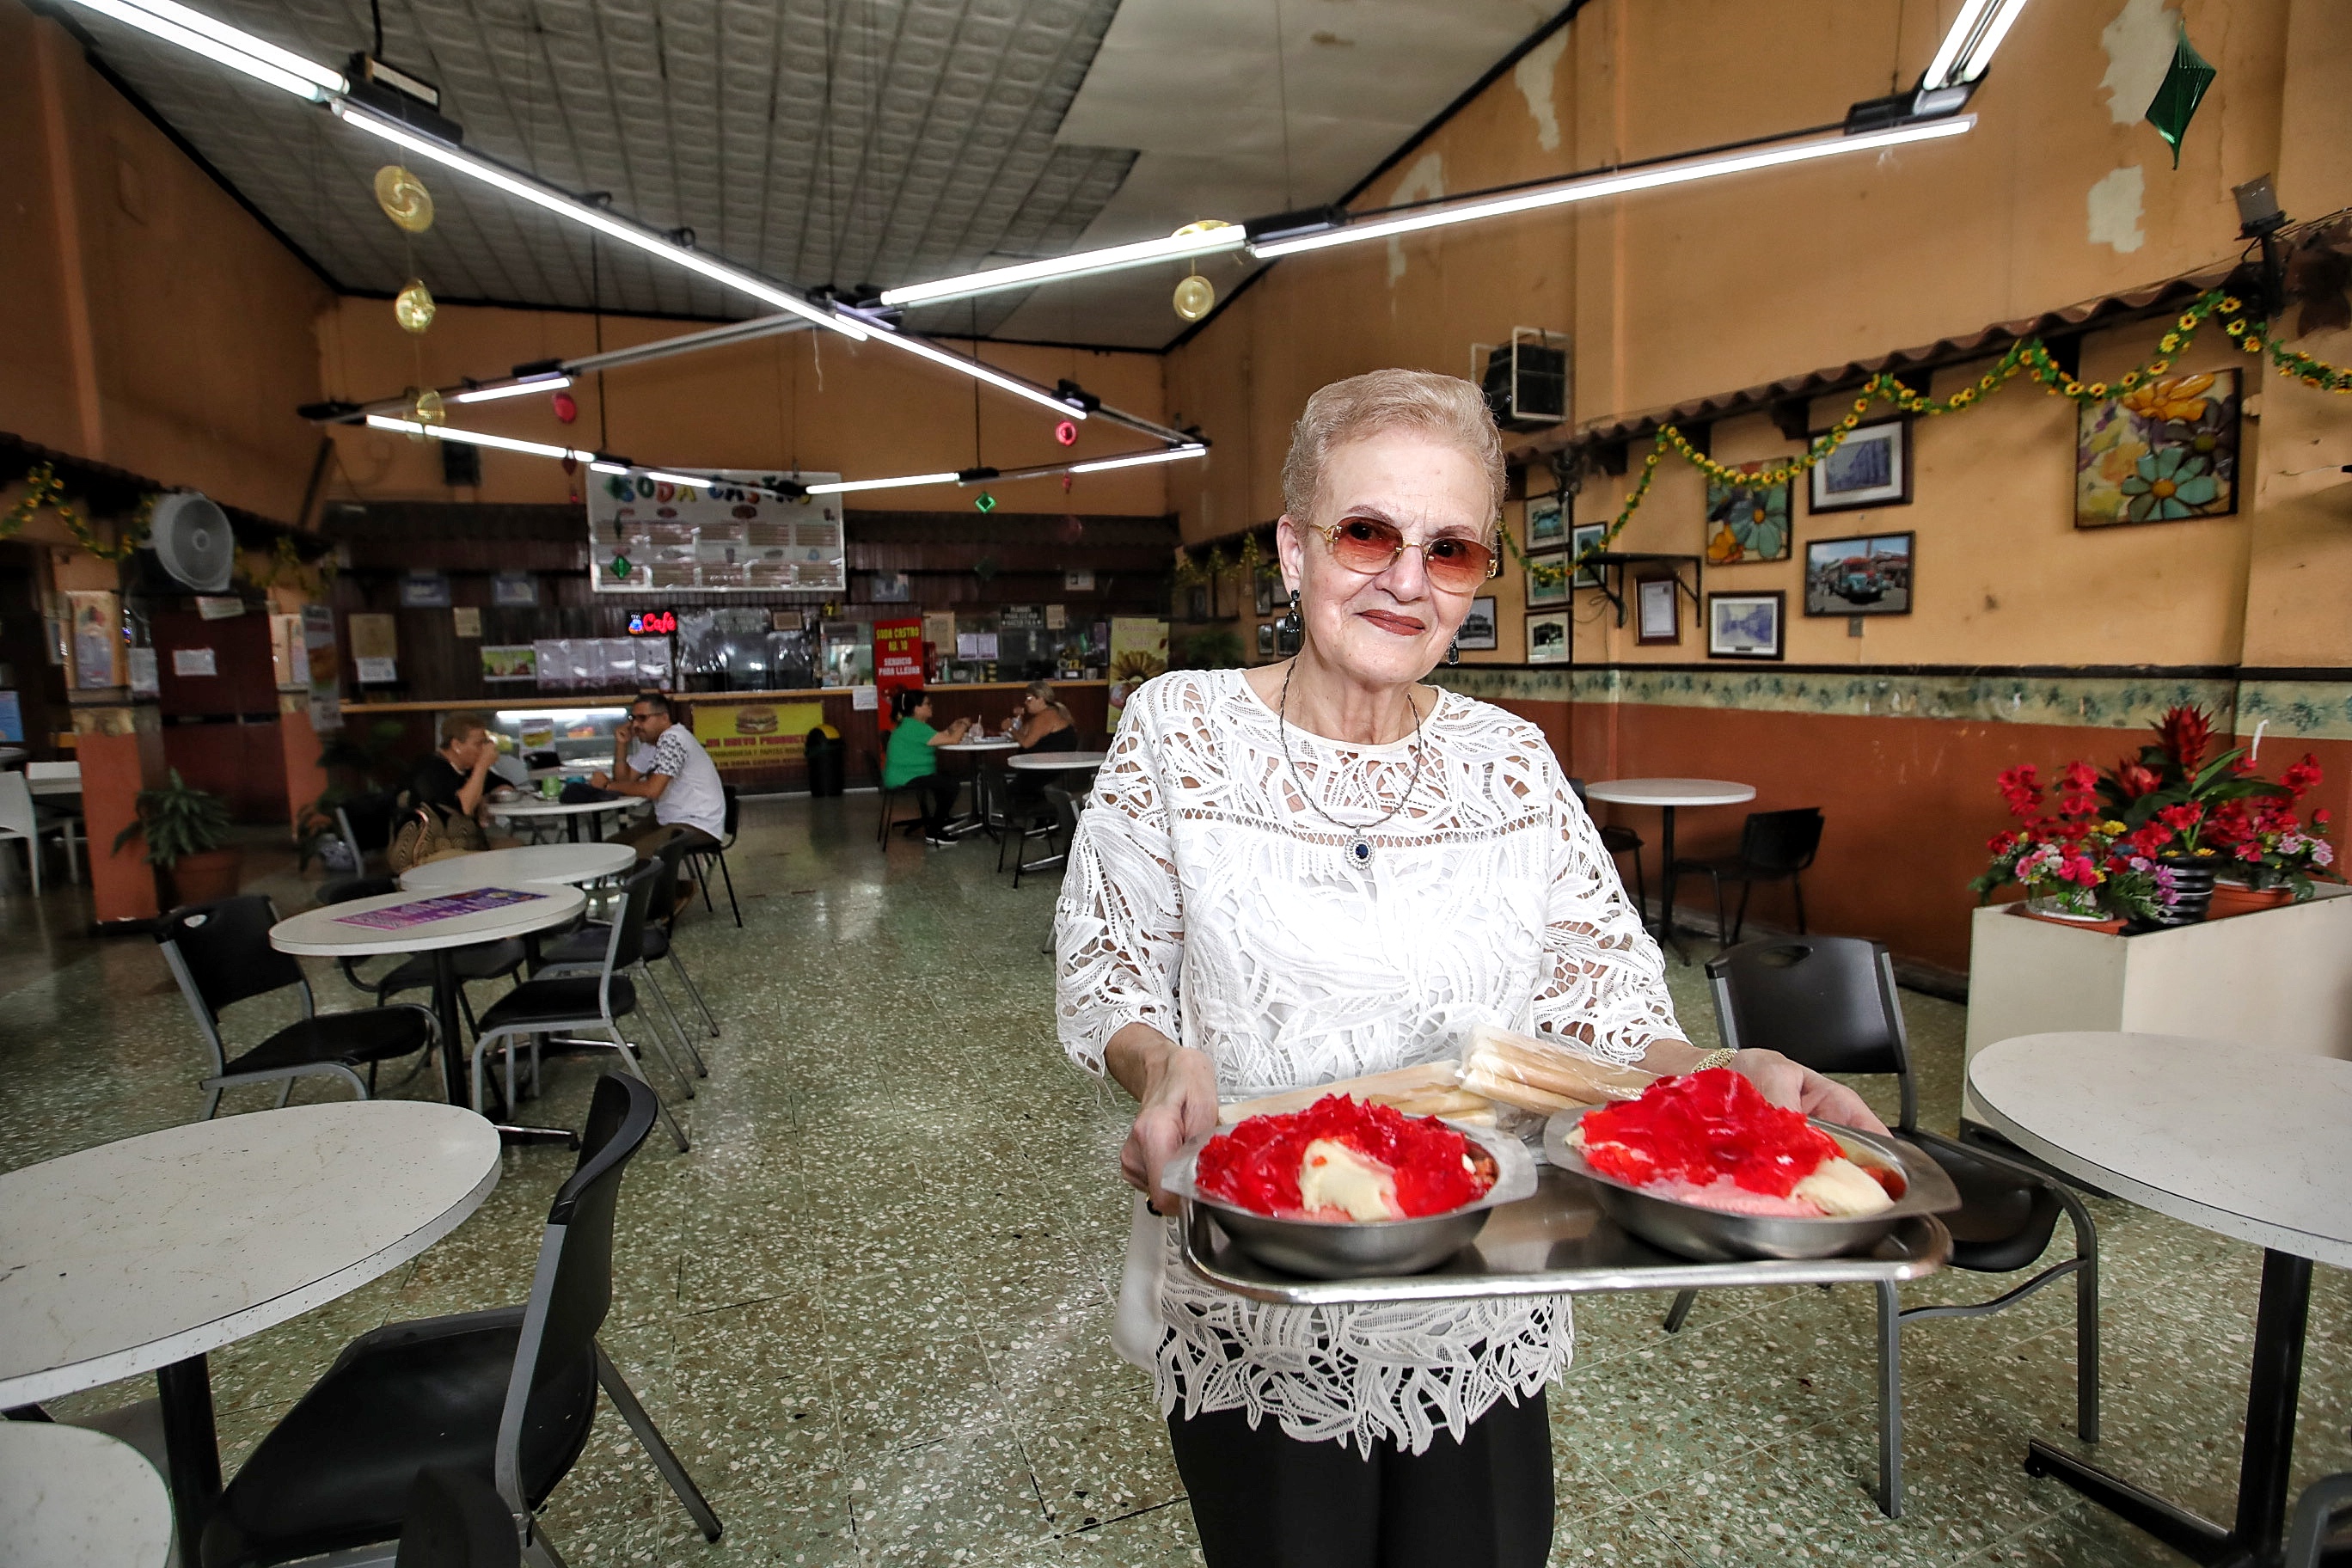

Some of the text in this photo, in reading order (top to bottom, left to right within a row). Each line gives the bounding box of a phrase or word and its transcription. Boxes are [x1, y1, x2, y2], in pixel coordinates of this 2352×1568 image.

[643, 611, 677, 634] Café
[876, 626, 920, 640] SODA CASTRO
[884, 657, 912, 666] SERVICIO
[878, 667, 895, 676] PARA
